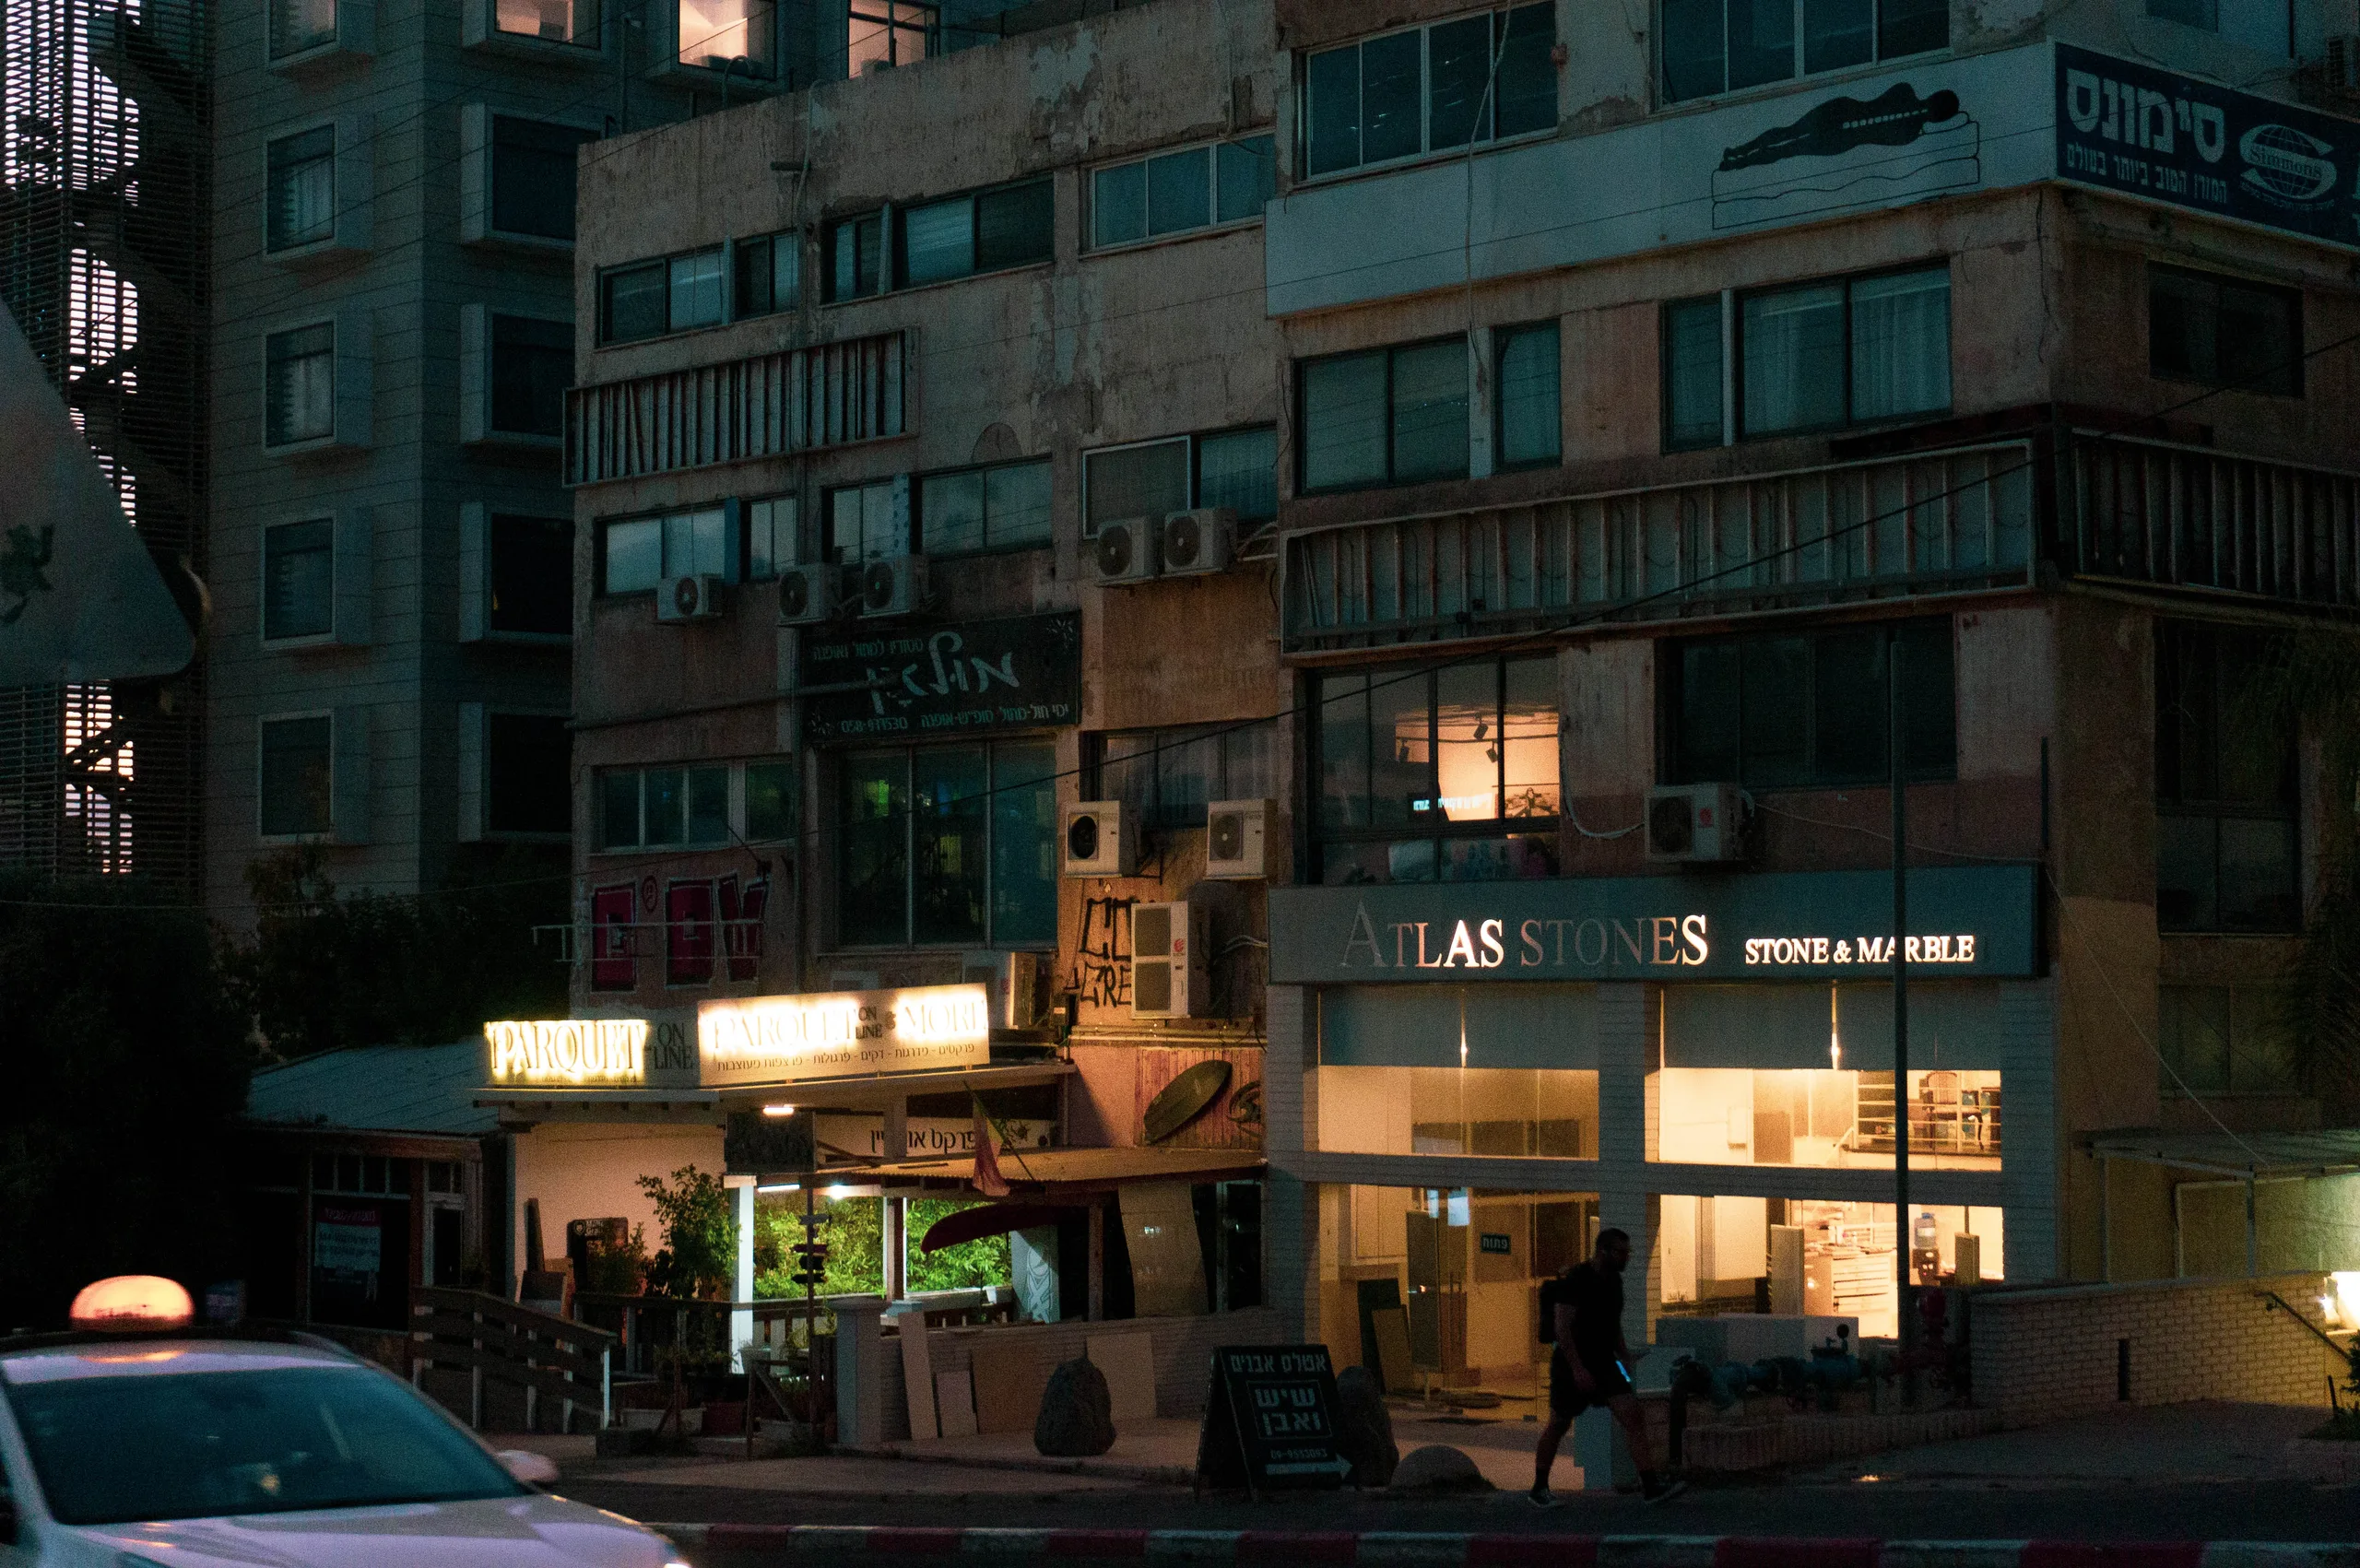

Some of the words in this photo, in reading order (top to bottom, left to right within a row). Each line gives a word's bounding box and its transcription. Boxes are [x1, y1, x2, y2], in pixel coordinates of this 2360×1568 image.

[2249, 145, 2322, 178] Simmons
[1519, 914, 1709, 966] STONES
[1745, 937, 1830, 964] STONE
[1833, 939, 1852, 964] &
[1857, 935, 1976, 963] MARBLE
[858, 1006, 877, 1021] ON
[657, 1022, 685, 1047] ON
[707, 1006, 857, 1049] PARQUET
[856, 1024, 883, 1040] LINE
[488, 1020, 646, 1073] PARQUET
[654, 1045, 694, 1070] LINE
[870, 1129, 926, 1153] אויין
[1230, 1353, 1276, 1373] אבנים
[1280, 1352, 1328, 1373] אטלס
[1254, 1387, 1316, 1408] שיש
[1261, 1411, 1322, 1436] ואבן
